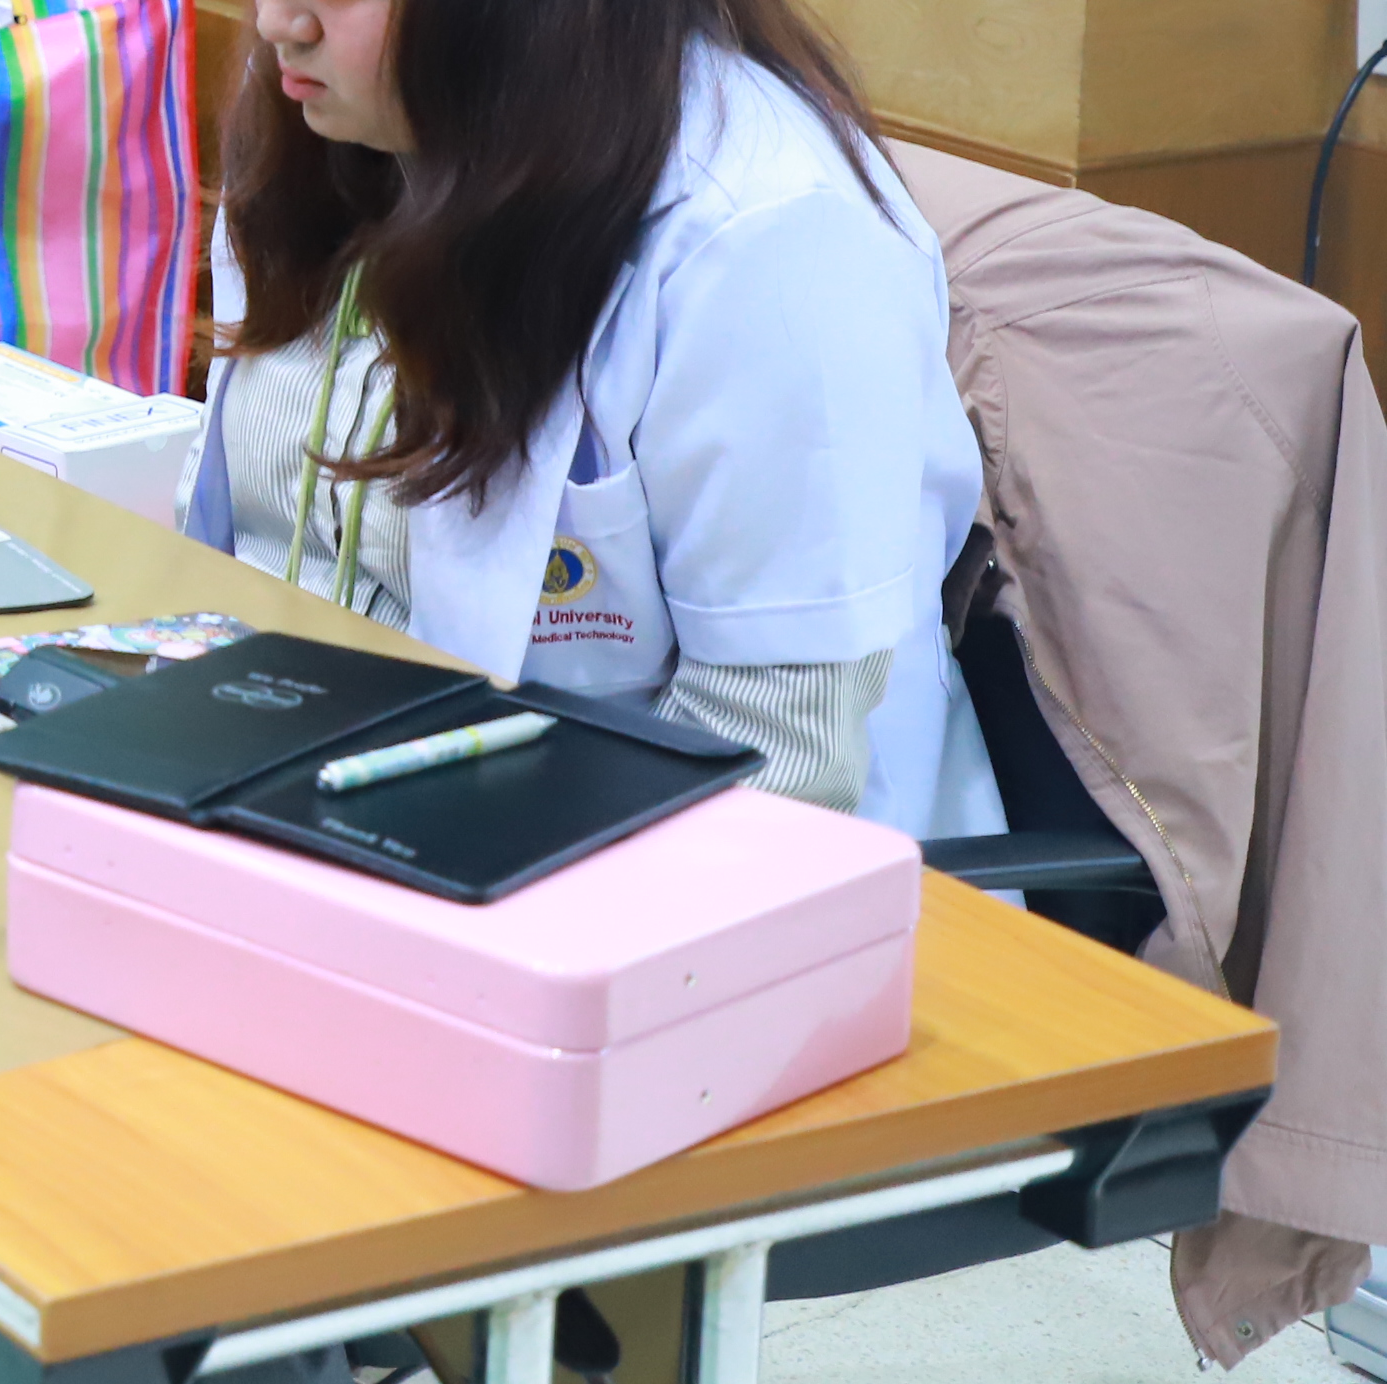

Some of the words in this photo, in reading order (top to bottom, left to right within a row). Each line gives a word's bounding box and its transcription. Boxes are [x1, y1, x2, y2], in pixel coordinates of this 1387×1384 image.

[549, 610, 634, 631] University
[532, 632, 573, 645] Medical
[575, 630, 635, 644] Technology
